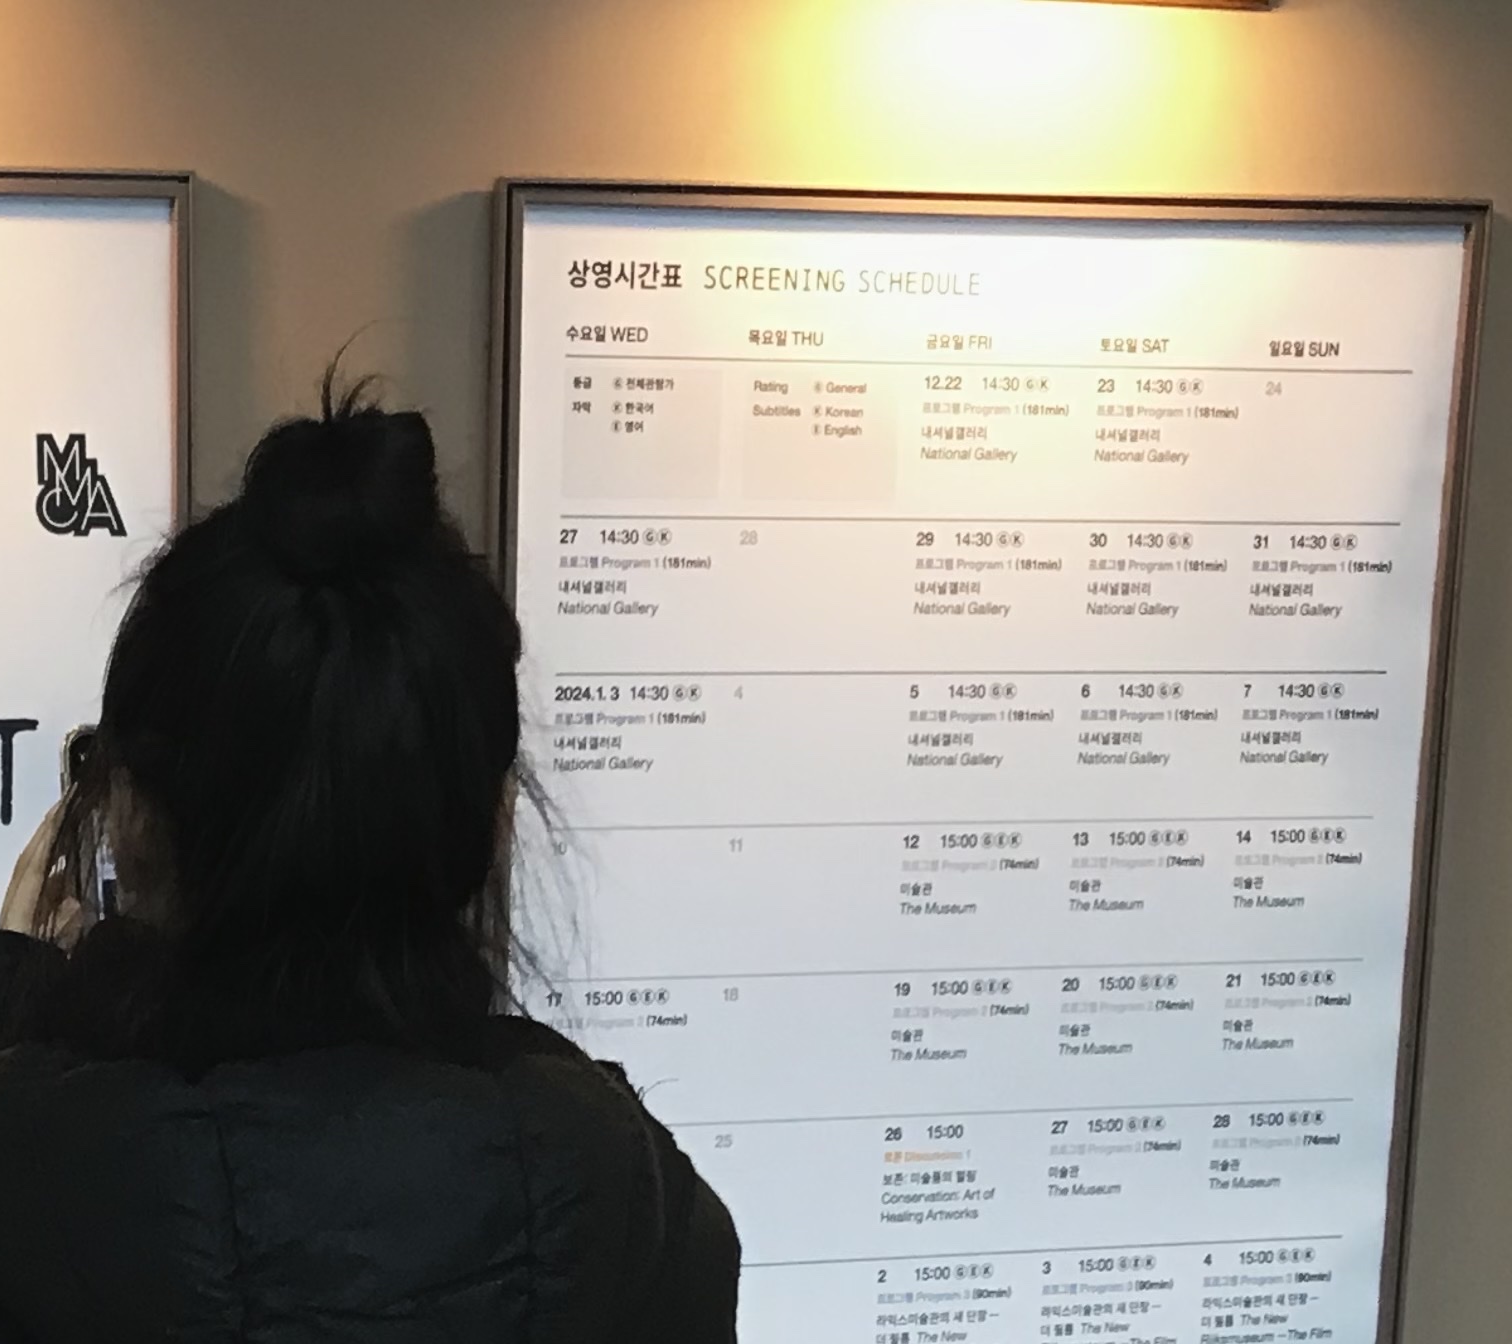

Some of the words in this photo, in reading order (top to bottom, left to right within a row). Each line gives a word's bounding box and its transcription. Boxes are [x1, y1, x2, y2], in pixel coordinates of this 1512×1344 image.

[568, 259, 682, 289] 상영시간표
[704, 265, 844, 292] SCREENING
[859, 270, 979, 295] SCHEDULE
[566, 326, 606, 342] 수요일
[610, 327, 648, 342] WED
[749, 330, 787, 346] 목요일
[792, 331, 823, 346] THU
[927, 334, 963, 350] 금요일
[969, 335, 992, 349] FRI
[1101, 338, 1137, 353] 토요일
[1142, 339, 1170, 353] SAT
[1269, 341, 1304, 357] 일요일
[1309, 342, 1340, 357] SUN
[754, 380, 788, 395] Rating
[826, 382, 867, 394] General
[925, 375, 962, 390] 12.22
[983, 377, 1019, 391] 14:30
[1097, 378, 1115, 393] 23
[1136, 379, 1173, 394] 14:30
[1265, 381, 1282, 396] 24
[825, 406, 863, 417] Korean
[824, 424, 862, 438] English
[921, 447, 971, 460] National
[974, 447, 1017, 463] Gallery
[1094, 449, 1145, 462] National
[1147, 449, 1189, 466] Gallery
[560, 529, 578, 544] 27
[600, 529, 639, 544] 14:30
[739, 530, 758, 545] 28
[916, 532, 934, 546] 29
[955, 532, 993, 547] 14:30
[1090, 533, 1107, 547] 30
[1128, 533, 1163, 548] 14:30
[1254, 535, 1268, 549] 31
[1290, 535, 1327, 549] 14:30
[558, 601, 611, 615] National
[613, 601, 658, 617] Gallery
[913, 602, 965, 615] National
[968, 601, 1011, 618] Gallery
[1086, 602, 1136, 615] National
[1138, 602, 1179, 618] Gallery
[1249, 603, 1298, 616] National
[1300, 603, 1342, 619] Gallery
[630, 686, 669, 701] 14:30
[910, 685, 919, 699] 5
[949, 684, 986, 699] 14:30
[1081, 684, 1090, 698] 6
[1119, 684, 1154, 698] 14:30
[1244, 684, 1252, 697] 7
[1278, 684, 1315, 698] 14:30
[553, 757, 606, 773] National
[608, 756, 653, 772] Gallery
[907, 754, 958, 766] National
[960, 752, 1003, 768] Gallery
[1077, 752, 1127, 765] National
[1129, 751, 1170, 766] Gallery
[1240, 750, 1287, 763] National
[1289, 750, 1329, 765] Gallery
[903, 835, 919, 849] 12
[941, 834, 978, 848] 15:00
[1073, 832, 1089, 846] 13
[1110, 831, 1146, 846] 15:00
[1237, 830, 1251, 843] 14
[1271, 829, 1305, 843] 15:00
[900, 902, 922, 915] The
[925, 902, 977, 915] Museum
[1069, 899, 1090, 911] The
[1093, 899, 1144, 911] Museum
[1256, 896, 1304, 907] Museum
[1062, 977, 1080, 992] 20
[1099, 976, 1135, 991] 15:00
[1226, 974, 1241, 988] 21
[1261, 972, 1295, 986] 15:00
[895, 982, 910, 996] 19
[932, 981, 968, 995] 15:00
[1082, 1042, 1133, 1054] Museum
[1245, 1037, 1294, 1050] Museum
[915, 1048, 967, 1060] Museum
[1051, 1120, 1068, 1134] 27
[1088, 1118, 1123, 1133] 15:00
[1213, 1114, 1230, 1128] 28
[1249, 1112, 1284, 1127] 15:00
[885, 1127, 902, 1141] 26
[927, 1124, 964, 1139] 15:00
[715, 1134, 733, 1149] 25
[1239, 1250, 1274, 1264] 15:00
[1042, 1261, 1051, 1274] 3
[1078, 1258, 1114, 1272] 15:00
[878, 1269, 886, 1283] 2
[915, 1266, 950, 1281] 15:00
[941, 1331, 967, 1342] New
